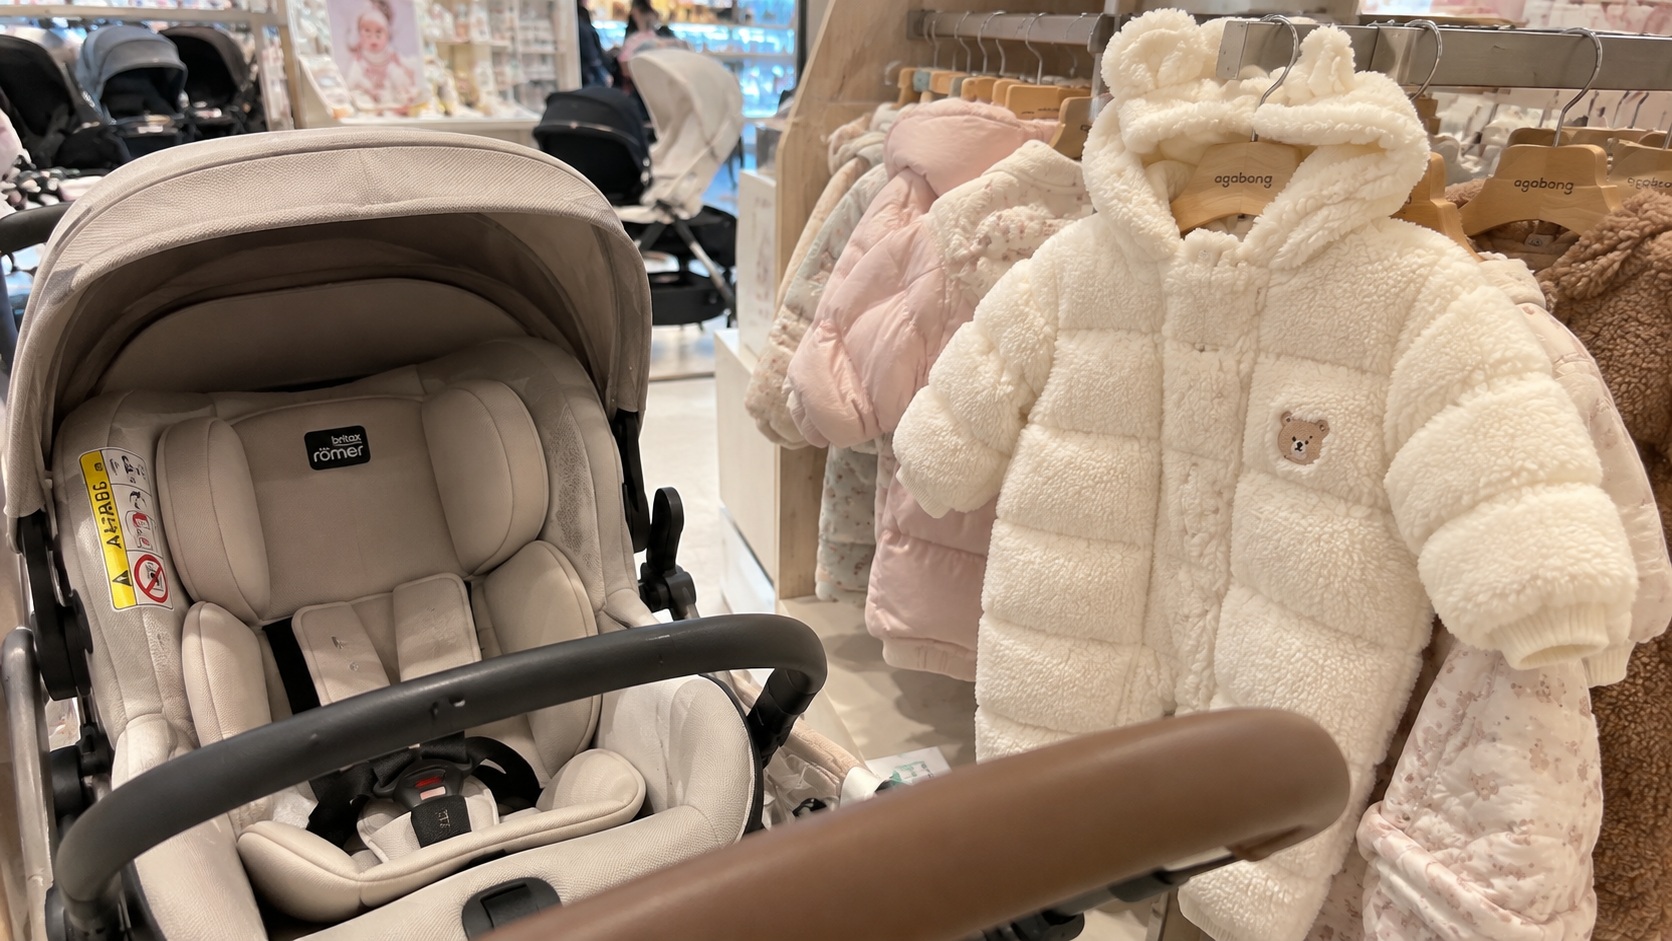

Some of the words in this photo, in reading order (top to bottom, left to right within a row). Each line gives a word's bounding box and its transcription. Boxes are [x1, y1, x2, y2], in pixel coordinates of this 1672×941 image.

[1214, 171, 1273, 189] agabong
[1513, 177, 1574, 195] agabong
[331, 433, 362, 445] britax
[313, 445, 364, 462] römer
